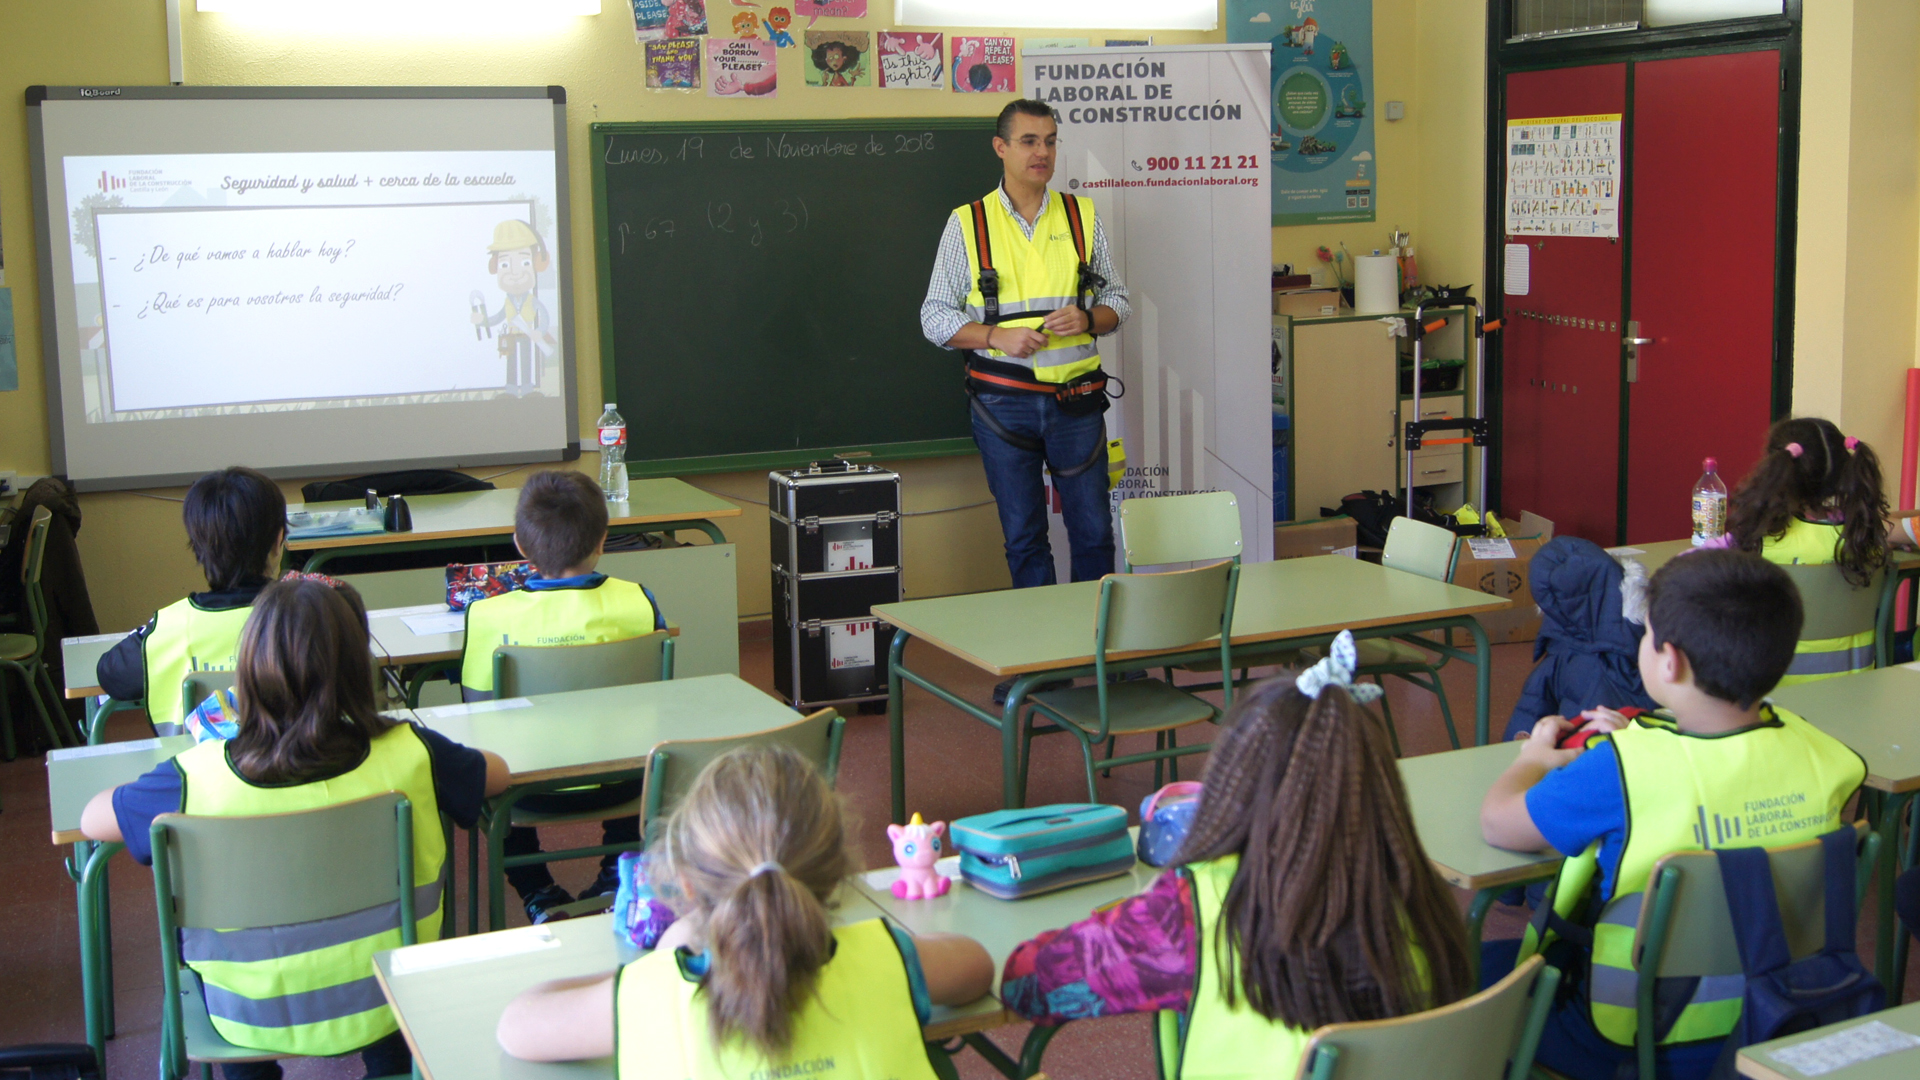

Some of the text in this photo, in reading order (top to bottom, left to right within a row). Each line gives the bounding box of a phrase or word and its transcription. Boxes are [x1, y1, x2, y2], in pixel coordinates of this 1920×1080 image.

[814, 5, 849, 16] mean?
[984, 38, 1013, 47] CAN YOU
[721, 63, 762, 71] PLEASE?
[883, 53, 927, 70] Is this
[984, 56, 1014, 66] PLEASE?
[1034, 57, 1166, 81] FUNDACIÓN
[885, 65, 932, 86] right?
[1035, 84, 1173, 103] LABORAL DE
[1069, 100, 1242, 124] CONSTRUCCIÓN
[604, 136, 669, 165] Lunes,
[676, 136, 704, 161] 19
[730, 135, 755, 160] de
[864, 133, 886, 156] de
[894, 132, 935, 153] 2018
[1146, 156, 1180, 171] 900
[1184, 156, 1206, 170] 11
[1210, 155, 1233, 170] 21
[1237, 155, 1259, 169] 21
[221, 175, 298, 195] Seguridad
[299, 178, 313, 193] y
[317, 174, 358, 188] salud
[379, 175, 418, 187] cerca
[423, 173, 441, 187] de
[444, 172, 459, 186] la
[463, 172, 516, 186] escuela
[1082, 176, 1259, 190] castillaleon.fundacionlaboral.org
[645, 219, 675, 240] 67
[749, 219, 763, 246] y
[133, 245, 169, 272] ¿De
[176, 247, 200, 269] qué
[207, 249, 246, 261] vamos
[252, 249, 260, 259] a
[266, 241, 312, 258] hablar
[318, 239, 356, 264] hoy?
[137, 292, 181, 319] ¿Qué
[187, 299, 203, 308] es
[206, 297, 240, 314] para
[246, 291, 304, 306] vosotros
[309, 286, 322, 302] la
[328, 283, 404, 308] seguridad?
[1124, 464, 1169, 477] DACIÓN
[1115, 479, 1155, 489] BORAL
[537, 633, 585, 645] FUNDACIÓN
[1744, 792, 1805, 812] FUNDACIÓN
[1746, 808, 1793, 826] LABORAL
[1748, 826, 1761, 838] DE
[1765, 824, 1778, 836] LA
